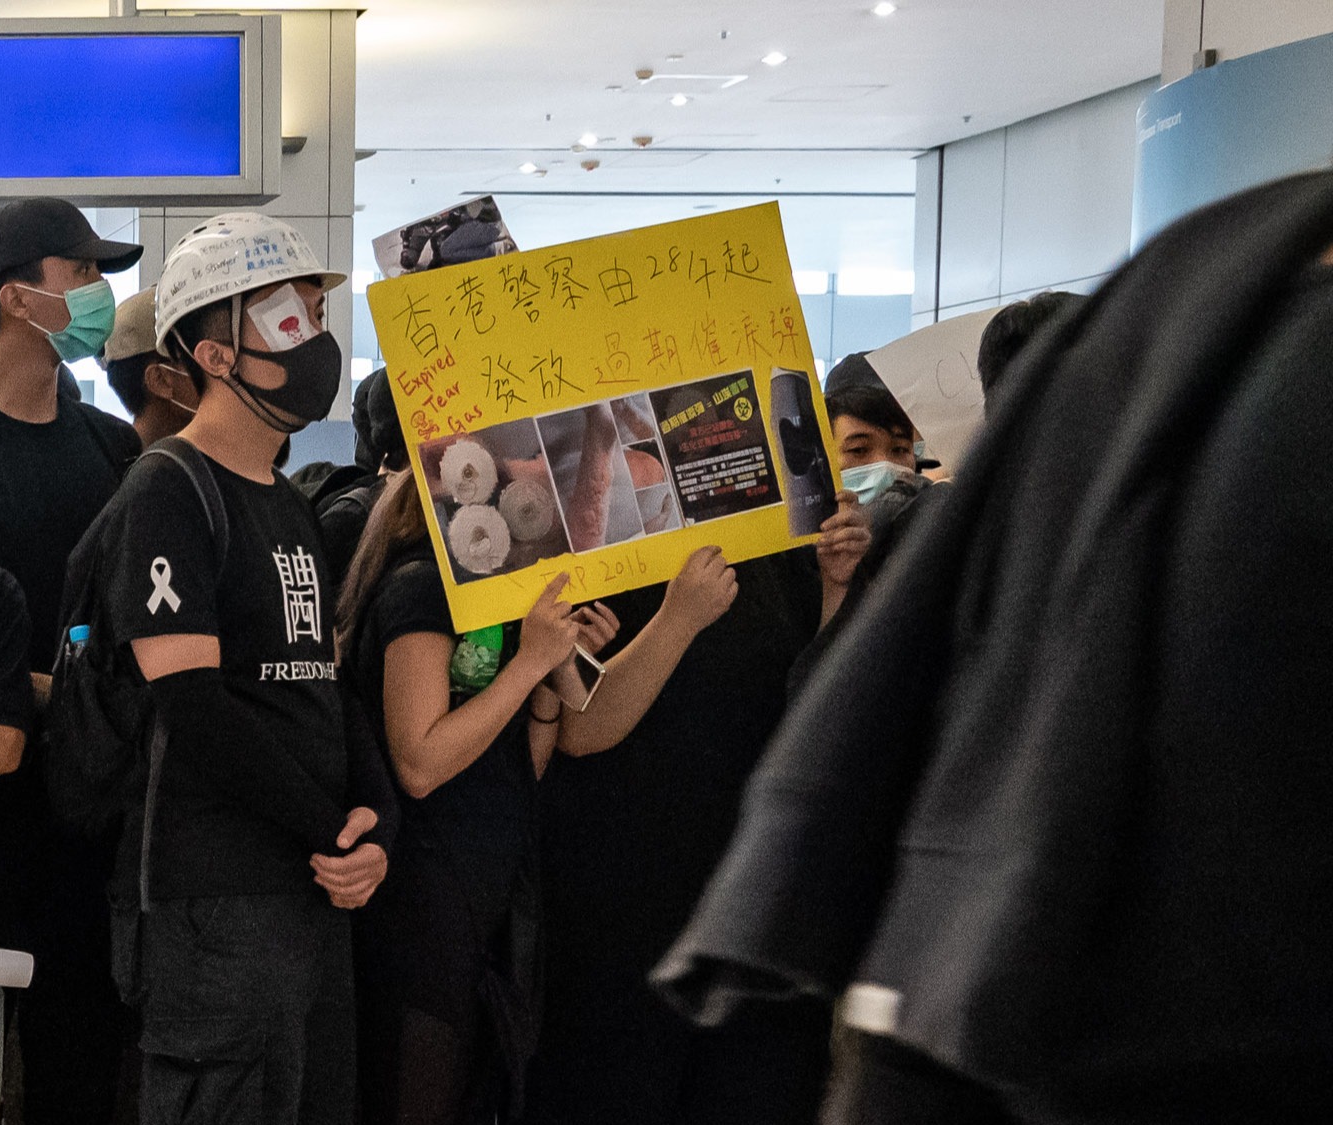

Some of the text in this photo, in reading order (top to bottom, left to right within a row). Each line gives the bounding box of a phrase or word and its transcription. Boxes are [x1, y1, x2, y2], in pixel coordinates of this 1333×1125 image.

[396, 349, 457, 393] Expired
[424, 380, 461, 414] Tear
[448, 403, 483, 436] Gas
[601, 550, 647, 582] 2016
